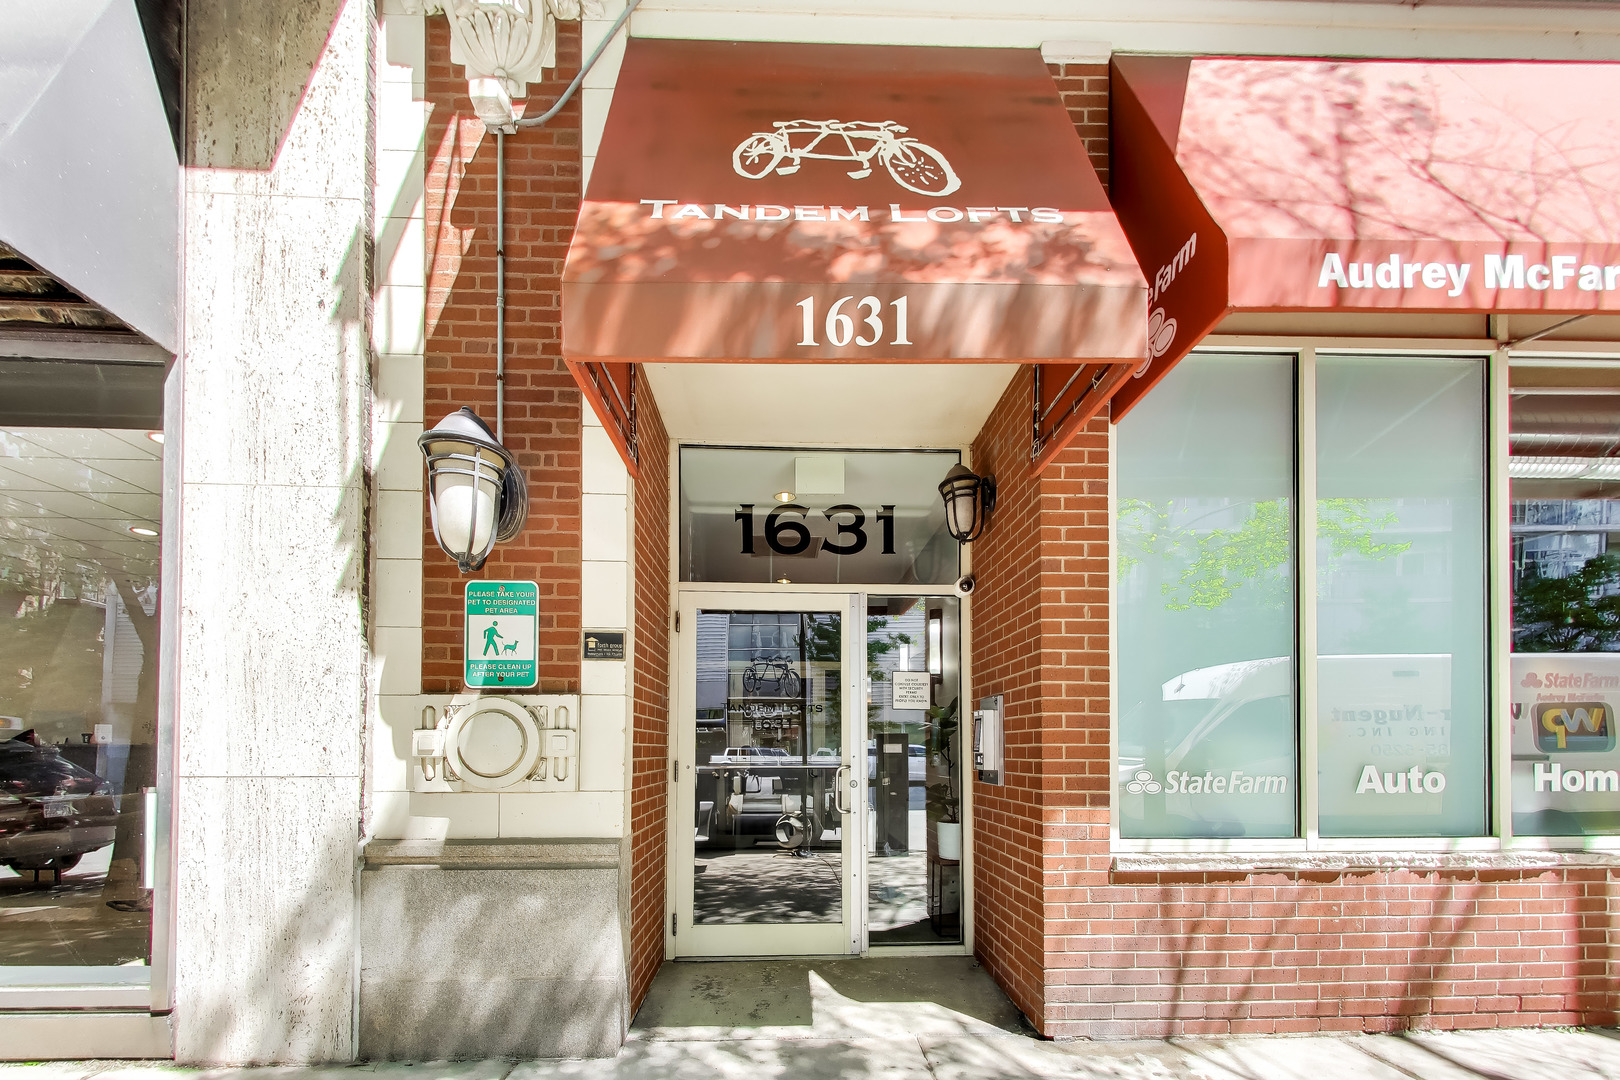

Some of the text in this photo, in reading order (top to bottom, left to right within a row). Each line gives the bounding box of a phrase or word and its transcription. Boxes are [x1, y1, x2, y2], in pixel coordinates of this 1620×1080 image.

[1317, 252, 1471, 298] Audrey
[796, 294, 913, 347] 1631
[734, 503, 896, 555] 1631
[1355, 764, 1446, 794] Auto
[1533, 763, 1619, 792] Hom
